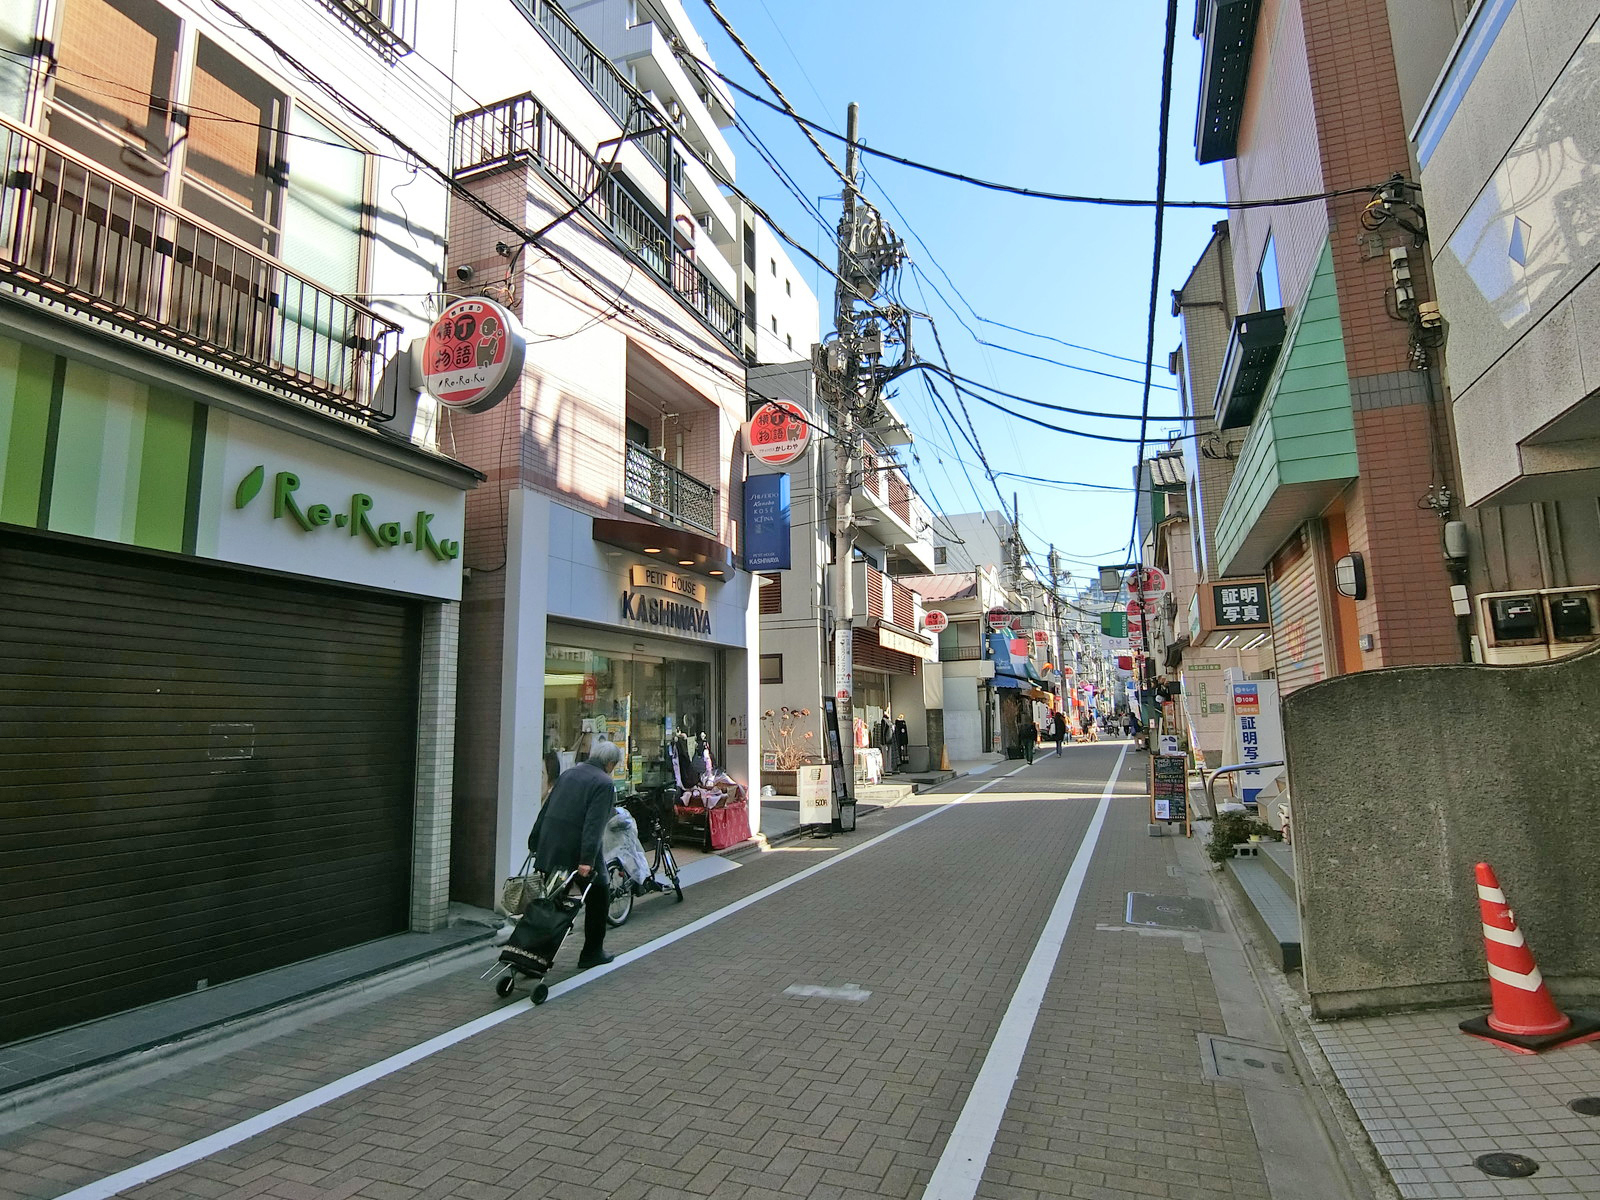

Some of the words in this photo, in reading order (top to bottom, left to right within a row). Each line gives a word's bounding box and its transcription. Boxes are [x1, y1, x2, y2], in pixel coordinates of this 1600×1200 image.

[435, 345, 471, 369] 物語
[758, 428, 783, 442] 物語
[775, 443, 798, 452] かしわや
[749, 556, 780, 565] KASHIWAYA
[646, 569, 667, 586] PETIT
[671, 576, 696, 595] HOUSE
[1221, 587, 1258, 606] 証明
[622, 591, 712, 635] KASHIWAYA
[1222, 605, 1260, 623] 写真
